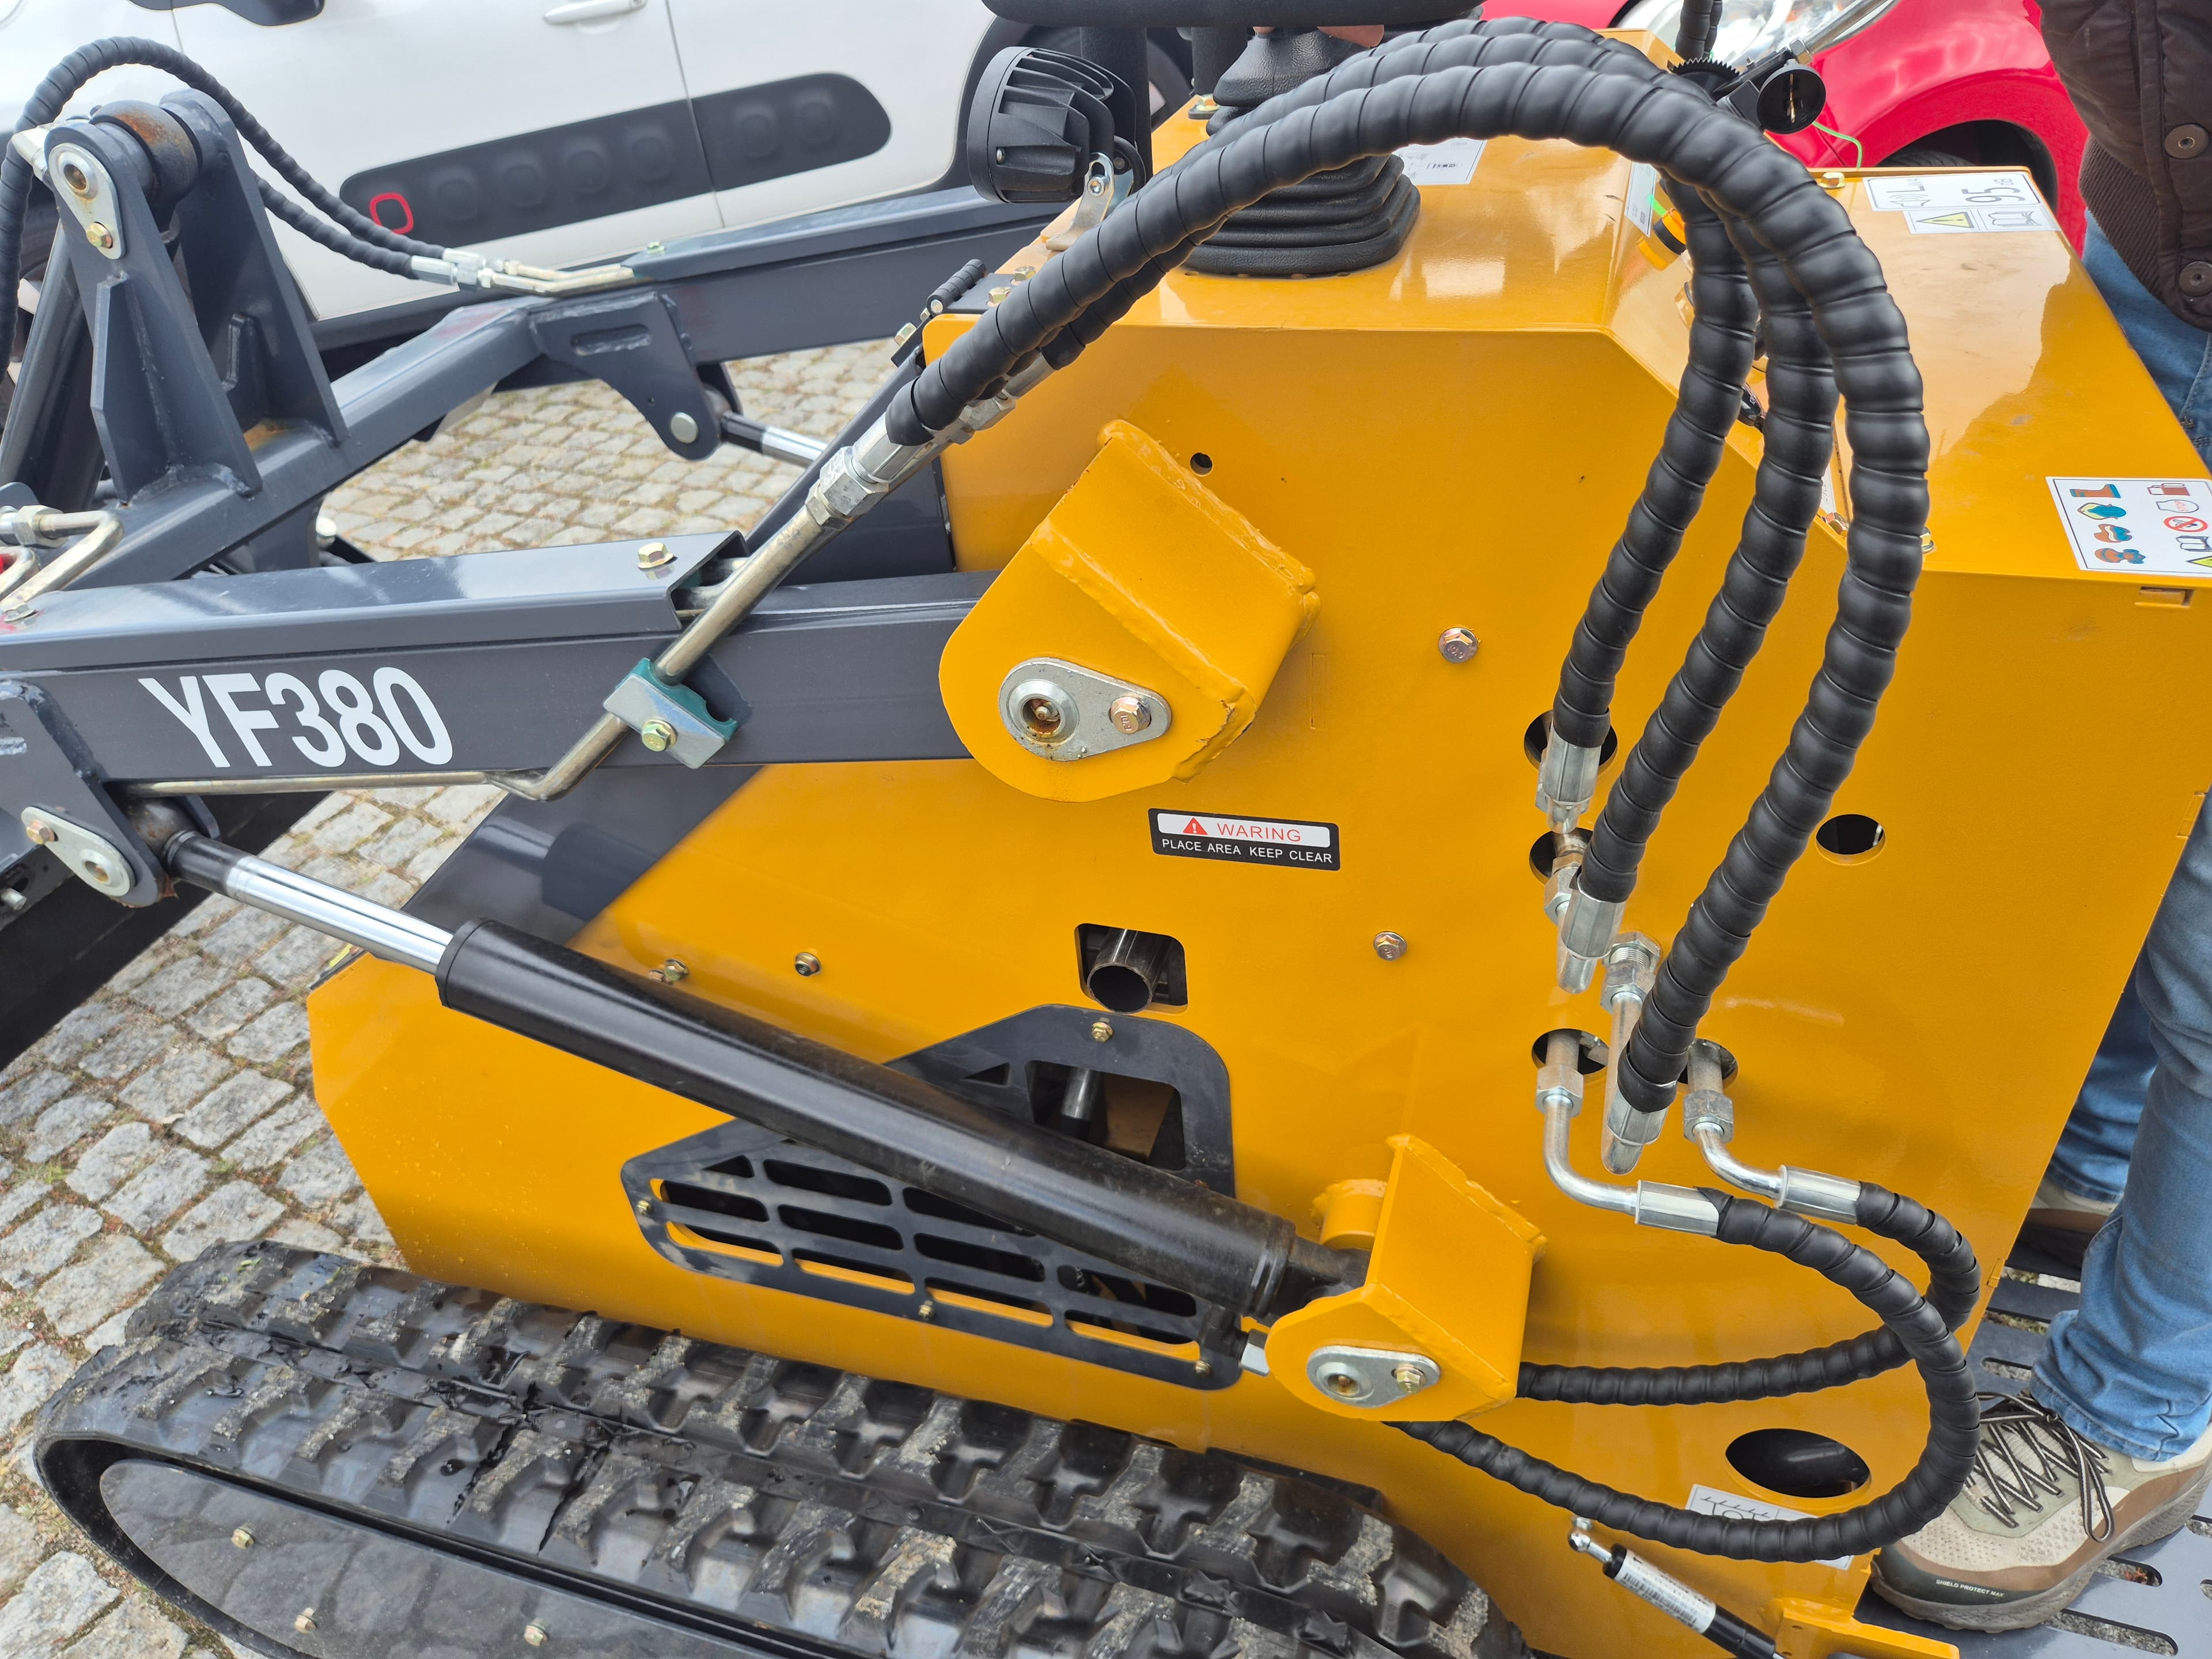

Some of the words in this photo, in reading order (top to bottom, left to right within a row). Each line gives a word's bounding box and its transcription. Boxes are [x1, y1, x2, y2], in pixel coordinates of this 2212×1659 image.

[1961, 187, 2026, 203] 95
[138, 666, 453, 767] YF380
[1217, 823, 1301, 842] WARING
[1162, 839, 1202, 851] PLACE
[1207, 843, 1241, 855] AREA
[1249, 846, 1283, 858] KEEP
[1289, 850, 1333, 863] CLEAR
[1936, 1579, 1959, 1588] SHIELD
[1959, 1584, 1990, 1594] PROTECT
